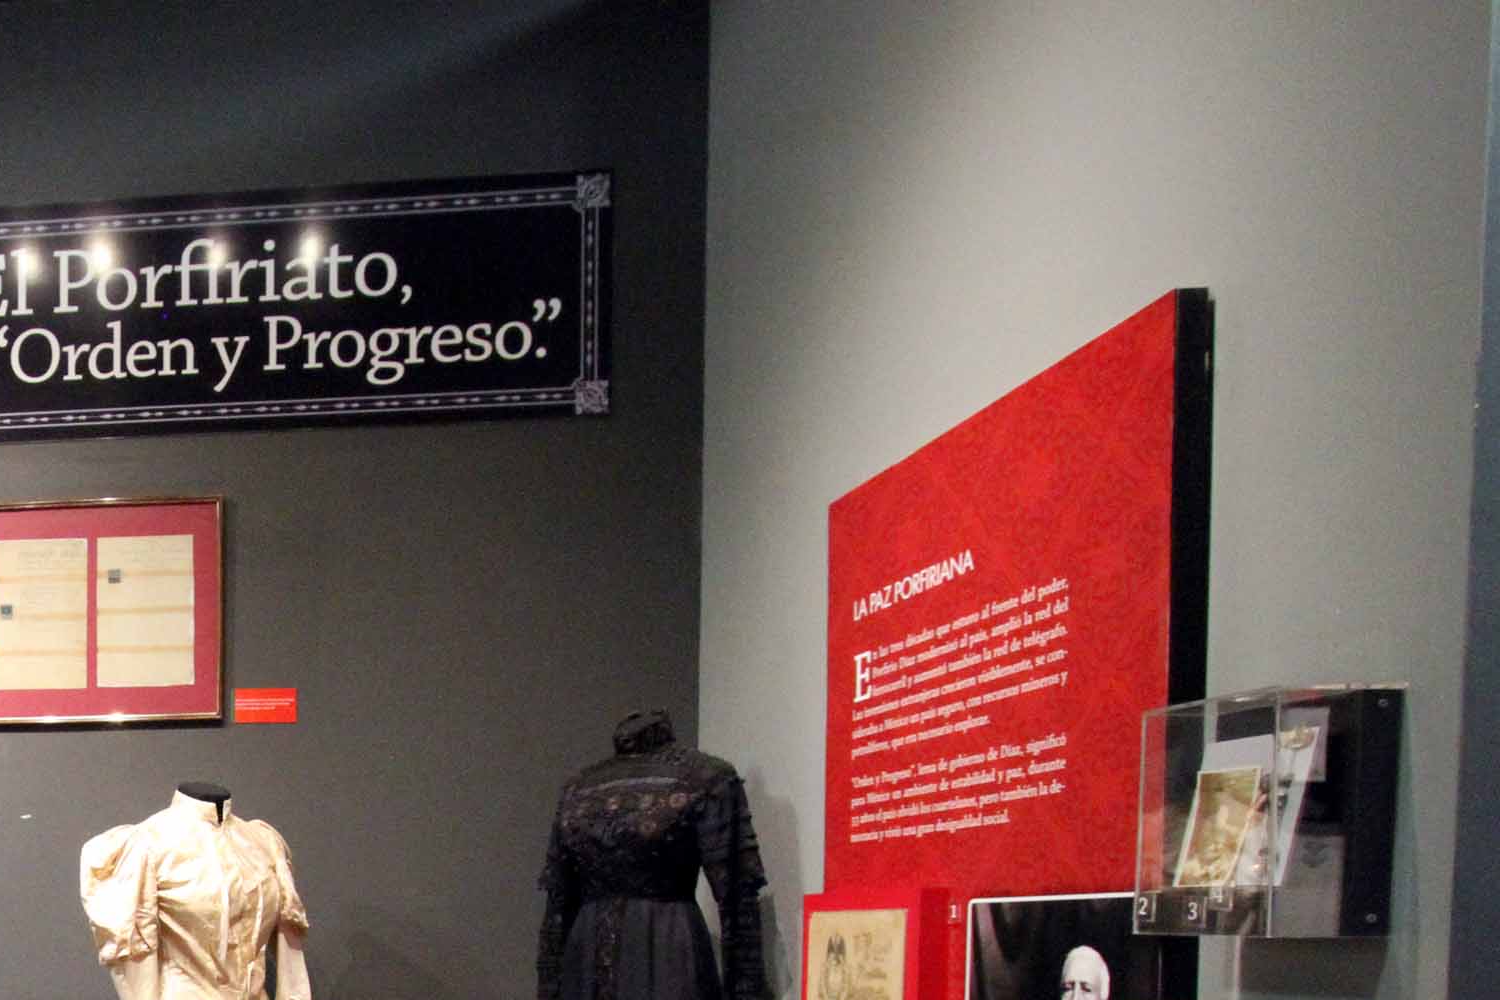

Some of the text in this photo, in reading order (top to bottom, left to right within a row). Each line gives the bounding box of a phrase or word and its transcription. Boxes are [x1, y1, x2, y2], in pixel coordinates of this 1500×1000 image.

[52, 237, 414, 315] Porfiriato,
[209, 335, 250, 393] y
[853, 549, 975, 621] LA PAZ PORFIRIANA
[1138, 896, 1148, 915] 2
[1187, 902, 1198, 921] 3
